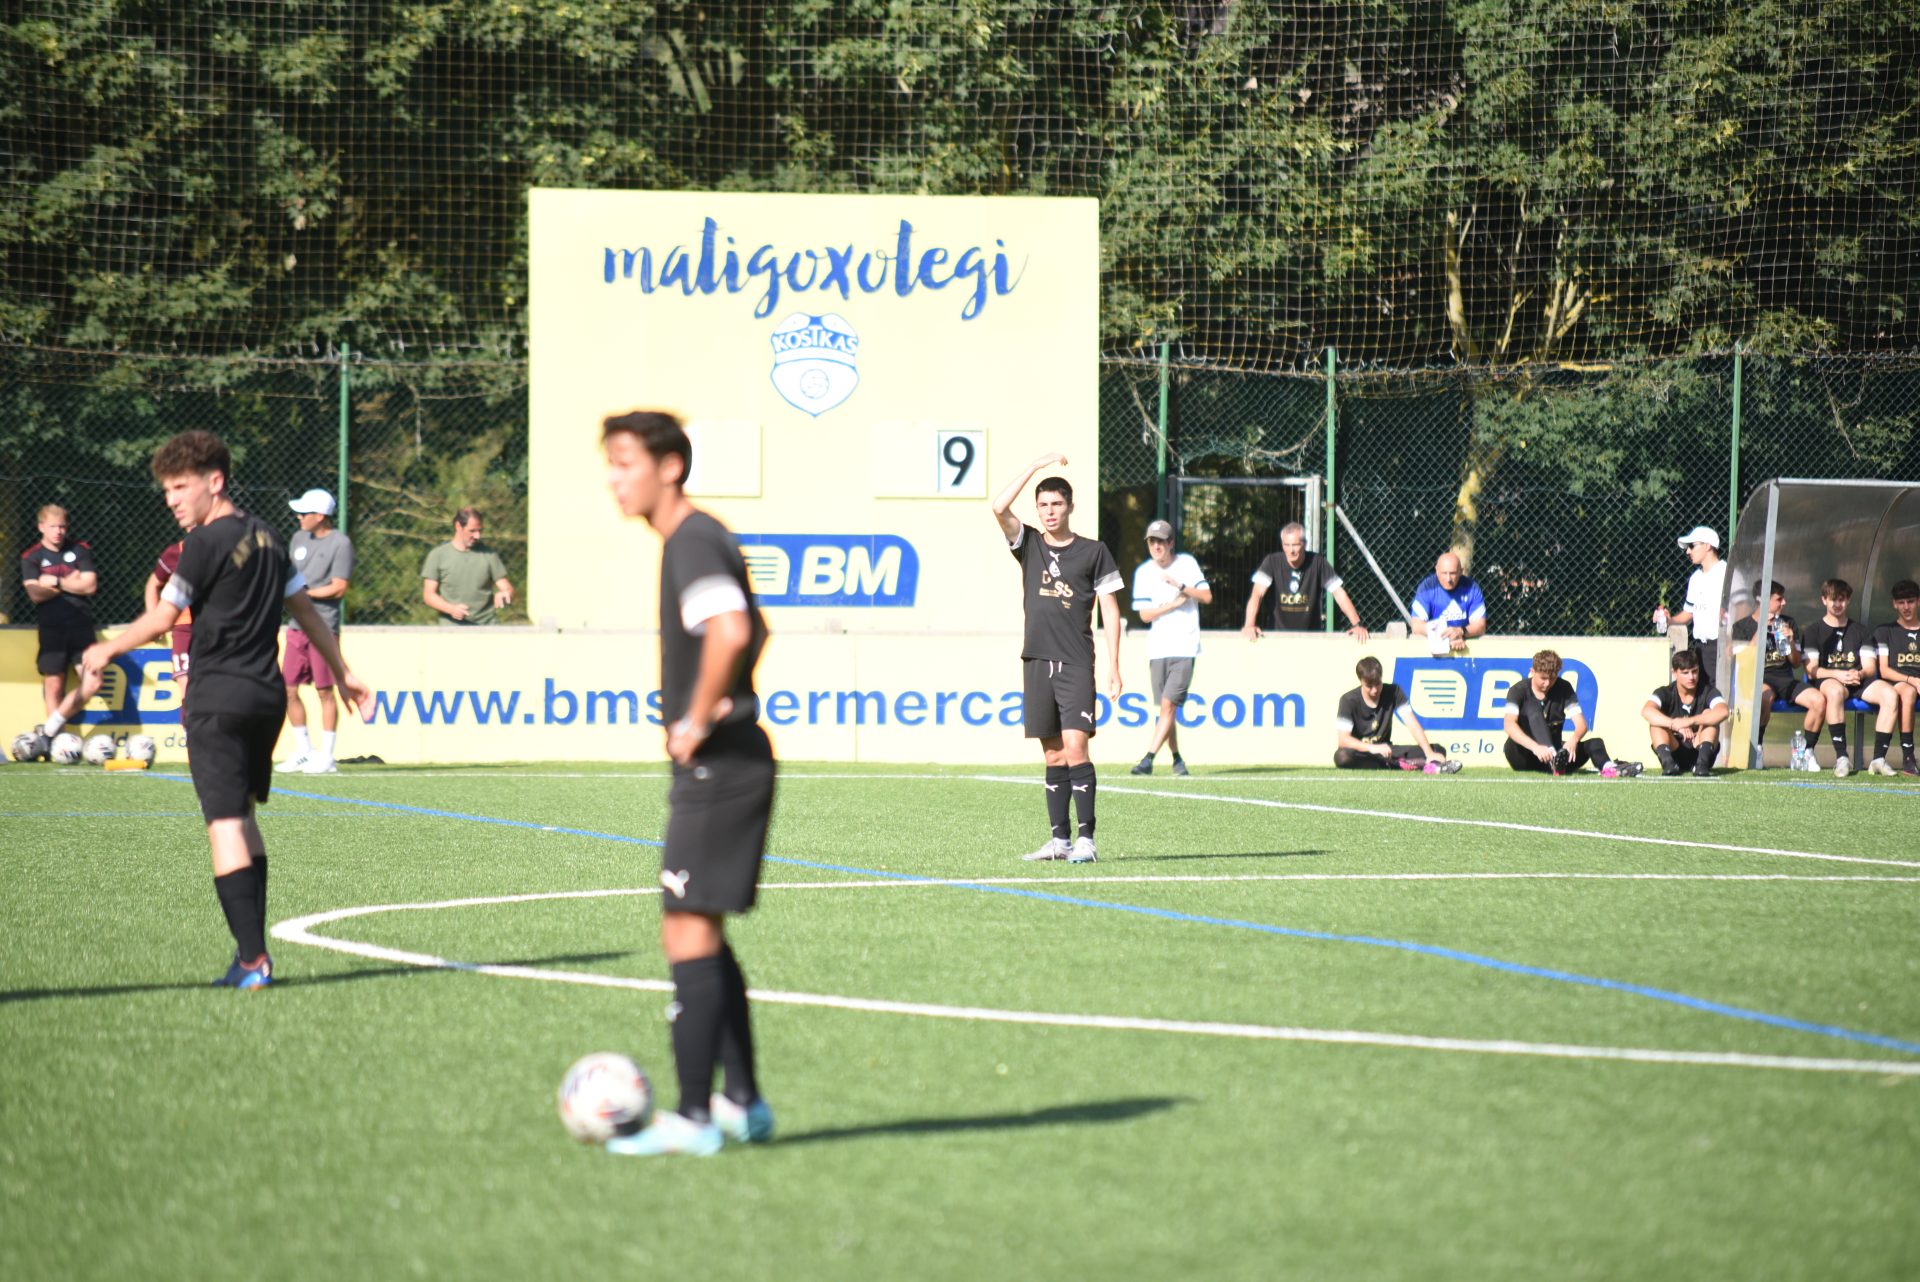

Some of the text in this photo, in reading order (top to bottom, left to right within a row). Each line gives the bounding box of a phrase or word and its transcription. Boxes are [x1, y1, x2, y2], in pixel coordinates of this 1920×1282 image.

[603, 216, 1028, 321] maligoxolegi
[771, 325, 858, 354] KOSTKAS
[942, 436, 975, 486] 9
[800, 545, 901, 595] BM
[1450, 738, 1494, 754] es lo
